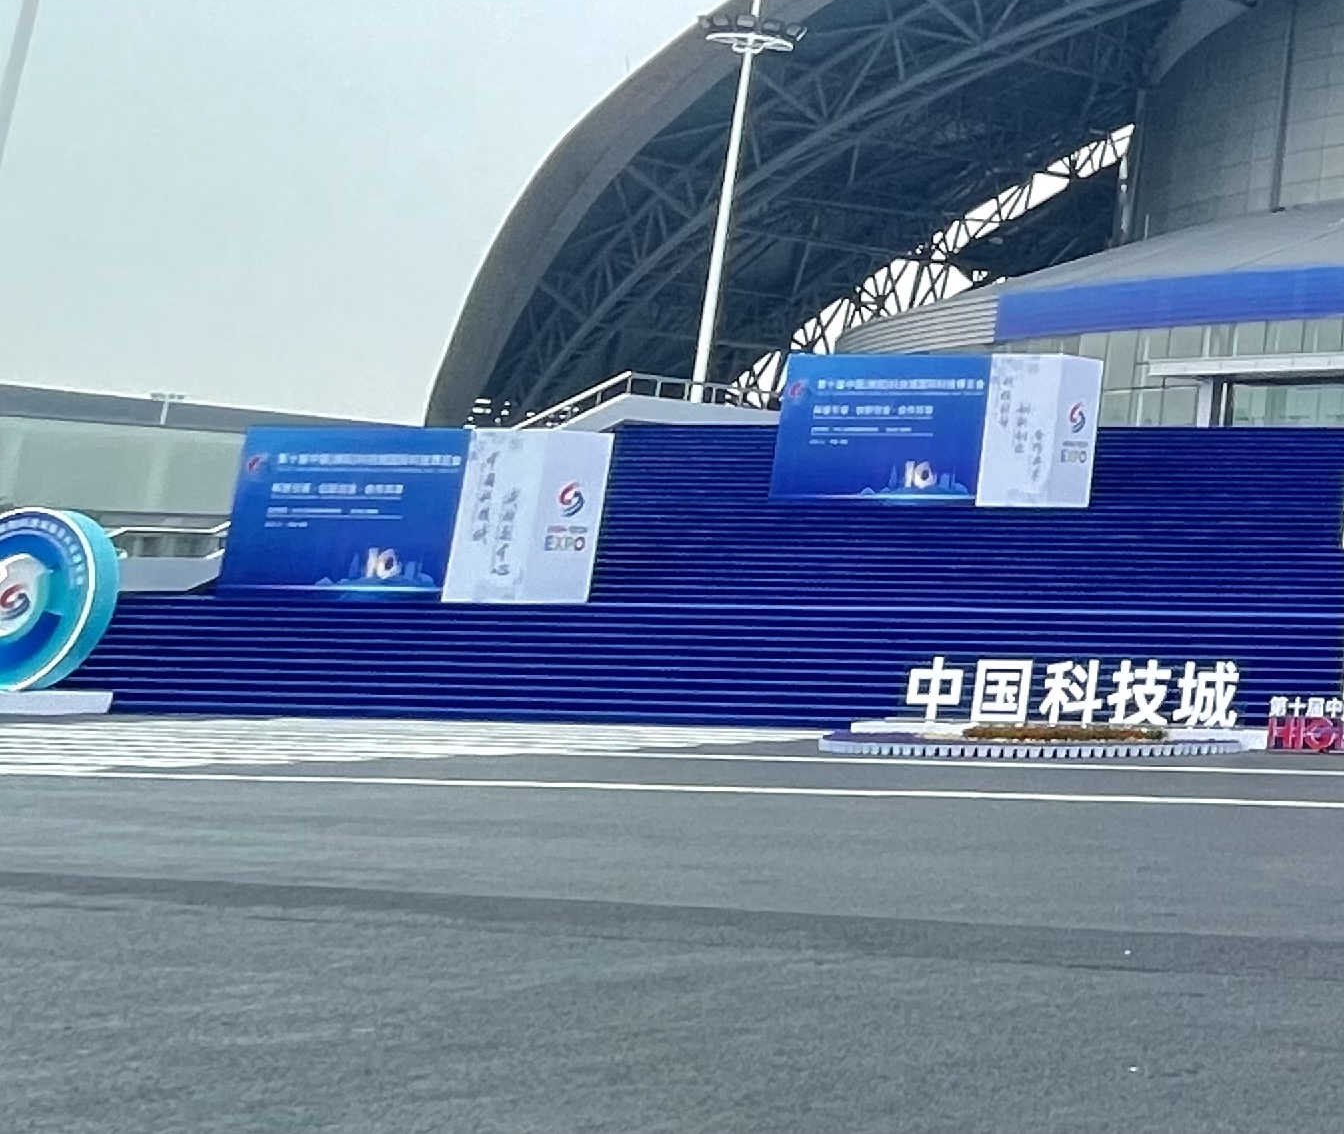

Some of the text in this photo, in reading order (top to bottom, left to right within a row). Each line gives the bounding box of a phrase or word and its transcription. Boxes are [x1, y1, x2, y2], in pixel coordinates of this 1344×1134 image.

[906, 656, 1241, 728] 中国科技城
